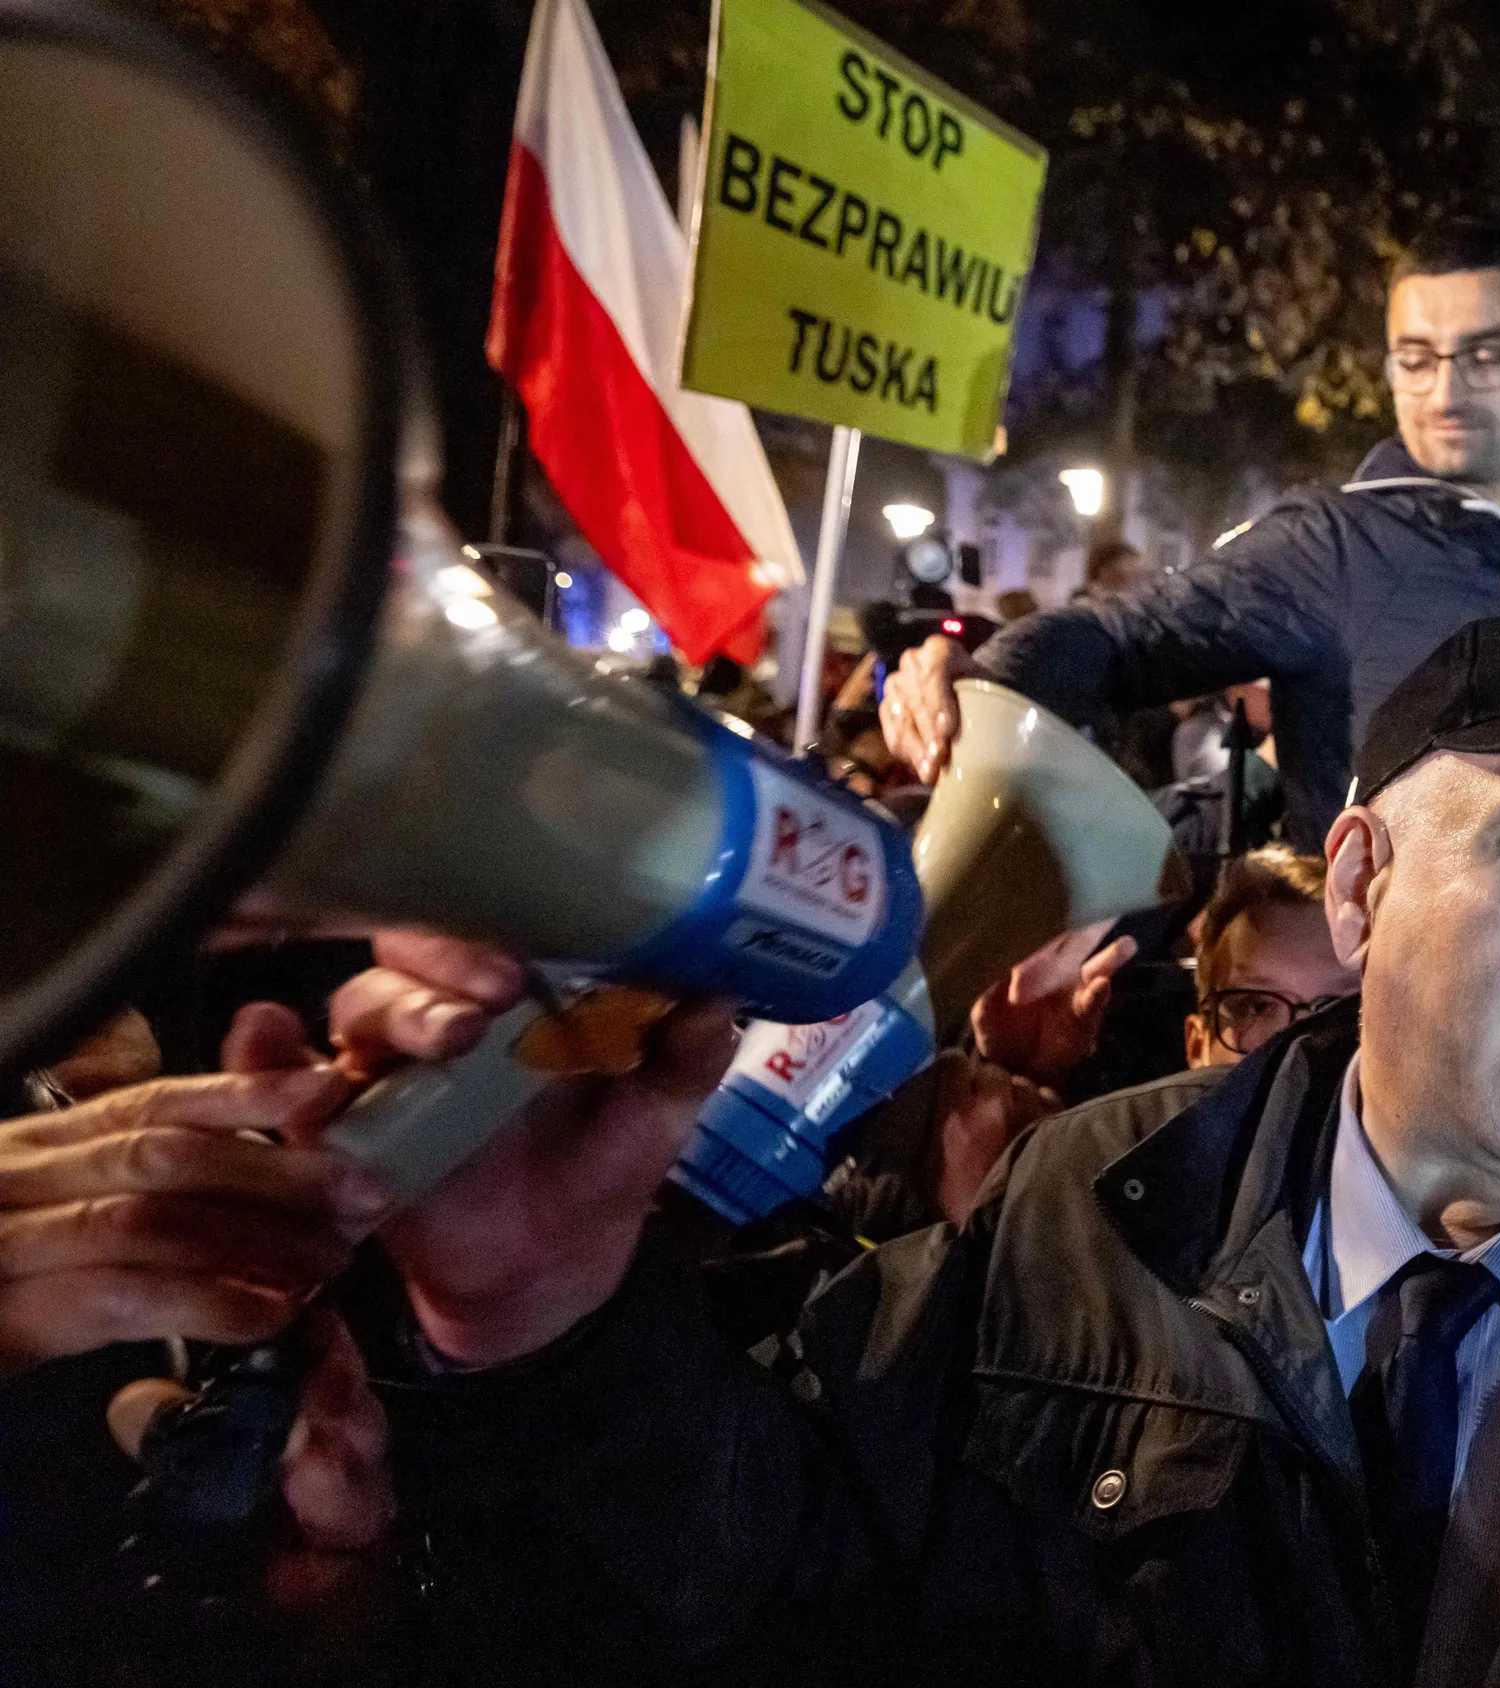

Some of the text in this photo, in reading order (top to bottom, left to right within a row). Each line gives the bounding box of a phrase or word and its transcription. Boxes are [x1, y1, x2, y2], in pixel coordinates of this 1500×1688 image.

[838, 49, 963, 170] STOP
[719, 134, 1020, 325] BEZPRAWIU
[788, 308, 939, 413] TUSKA
